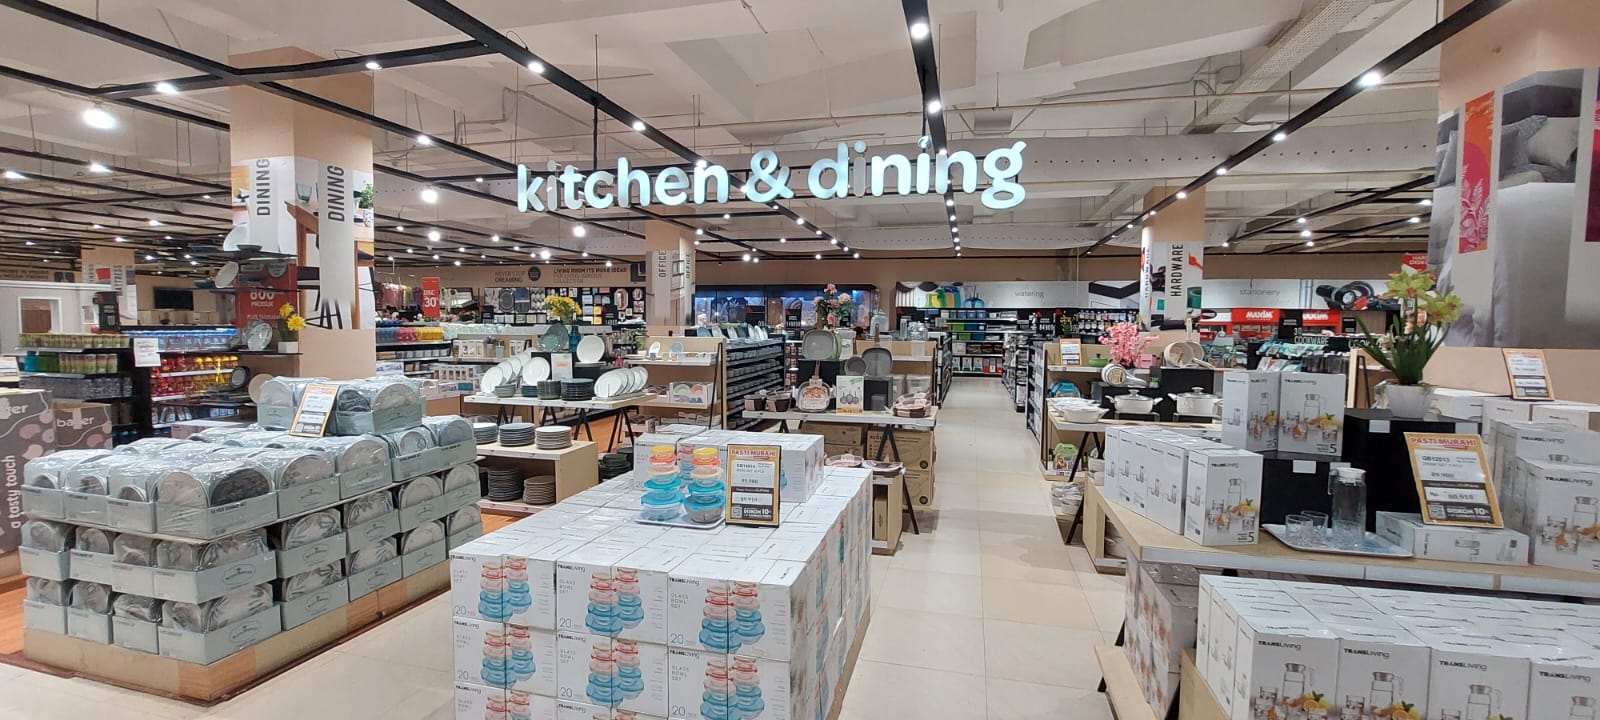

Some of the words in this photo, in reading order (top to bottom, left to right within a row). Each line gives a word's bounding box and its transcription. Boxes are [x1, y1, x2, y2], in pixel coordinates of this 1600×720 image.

[516, 157, 729, 213] kitchen
[745, 150, 795, 203] &
[807, 136, 1027, 210] dining
[256, 159, 271, 216] DINING
[327, 165, 345, 222] DINING
[658, 250, 667, 278] OFFICE
[1170, 244, 1184, 297] HARDWARE
[1014, 289, 1045, 299] watering
[1240, 289, 1280, 297] stationery
[1411, 437, 1438, 445] PASTI
[1329, 443, 1338, 454] 5
[1, 455, 18, 487] touch
[6, 489, 21, 519] tasty
[11, 520, 21, 529] a
[1246, 531, 1255, 543] 5
[455, 605, 466, 615] 20
[560, 617, 571, 628] 20
[671, 633, 684, 644] 20
[1258, 640, 1301, 651] TRANSLiving
[1344, 648, 1389, 659] TRANSLiving
[1440, 660, 1487, 671] TRANSLiving
[457, 670, 468, 680] 20
[1539, 671, 1592, 683] TRANSLiving
[560, 687, 572, 698] 20
[672, 705, 685, 717] 20
